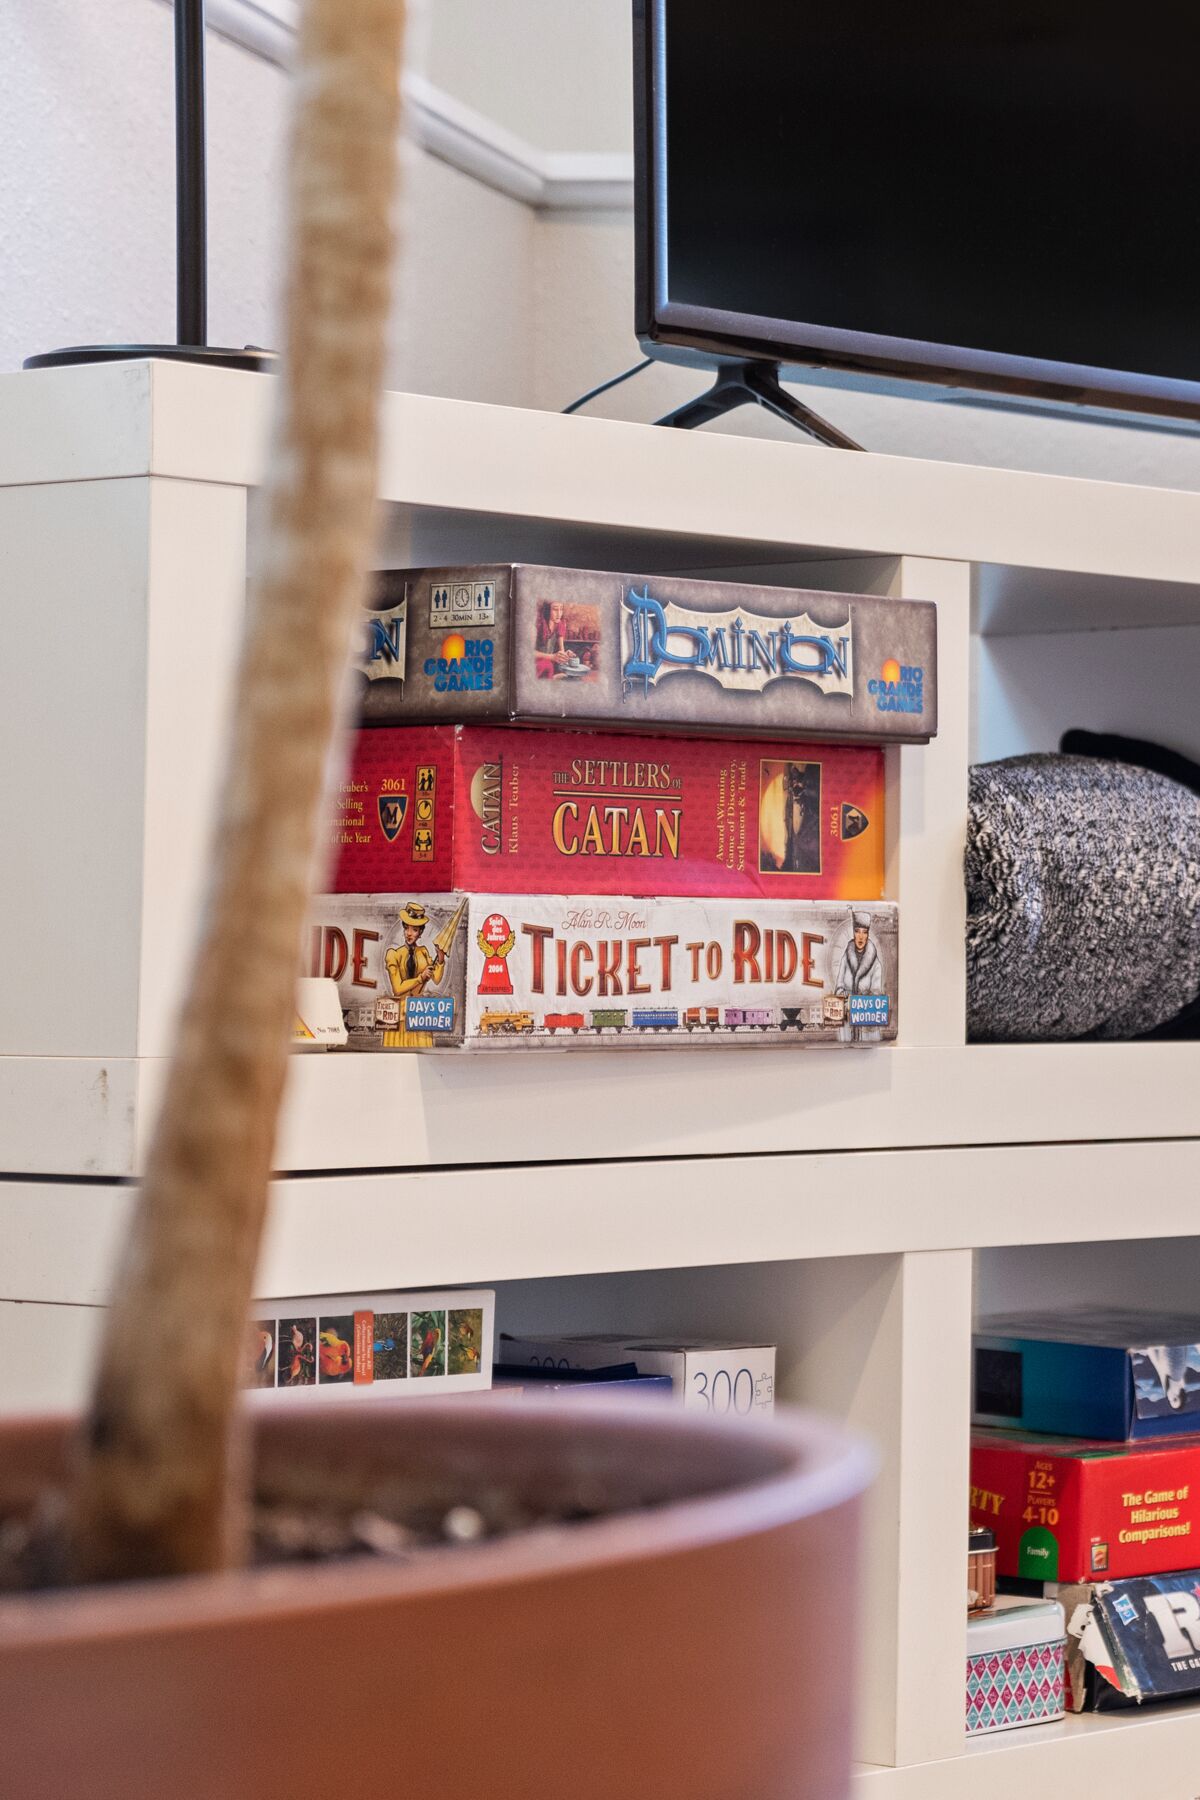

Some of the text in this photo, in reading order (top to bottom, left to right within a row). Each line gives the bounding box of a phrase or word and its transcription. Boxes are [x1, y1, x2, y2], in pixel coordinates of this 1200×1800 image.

[465, 639, 494, 657] RIO
[424, 657, 494, 676] GRANDE
[899, 666, 923, 683] RIO
[434, 675, 494, 692] GAMES
[867, 679, 923, 699] GRANDE
[876, 697, 923, 714] GAMES
[553, 771, 569, 784] THE
[571, 759, 671, 789] SETTLERS
[738, 760, 747, 797] Trade
[381, 779, 406, 791] 3061
[336, 798, 363, 813] Selling
[481, 759, 502, 856] CATAN
[509, 764, 520, 853] Klaus Teuber
[715, 769, 727, 861] Award-Winning
[552, 801, 683, 860] CATAN
[830, 805, 840, 837] 3061
[341, 832, 353, 843] the
[355, 832, 371, 843] Year
[727, 825, 736, 837] of
[736, 810, 746, 871] Settlement
[726, 840, 735, 870] Game
[561, 909, 592, 931] Alan
[614, 910, 647, 931] Moon
[312, 926, 379, 988] IDE
[521, 919, 825, 997] TICKET TO RIDE
[409, 1000, 451, 1014] DAYS OF
[851, 998, 887, 1010] DAYS OF
[383, 1011, 398, 1021] RIDE
[408, 1015, 451, 1028] WONDER
[851, 1011, 887, 1024] WONDER
[693, 1368, 753, 1417] 300
[1028, 1471, 1056, 1489] 12+
[1121, 1486, 1190, 1508] The Game of
[1022, 1506, 1059, 1525] 4-10
[1130, 1507, 1180, 1524] Hilarious
[1119, 1521, 1191, 1545] Comparisons!
[1027, 1546, 1049, 1560] Family
[1171, 1660, 1188, 1673] THE
